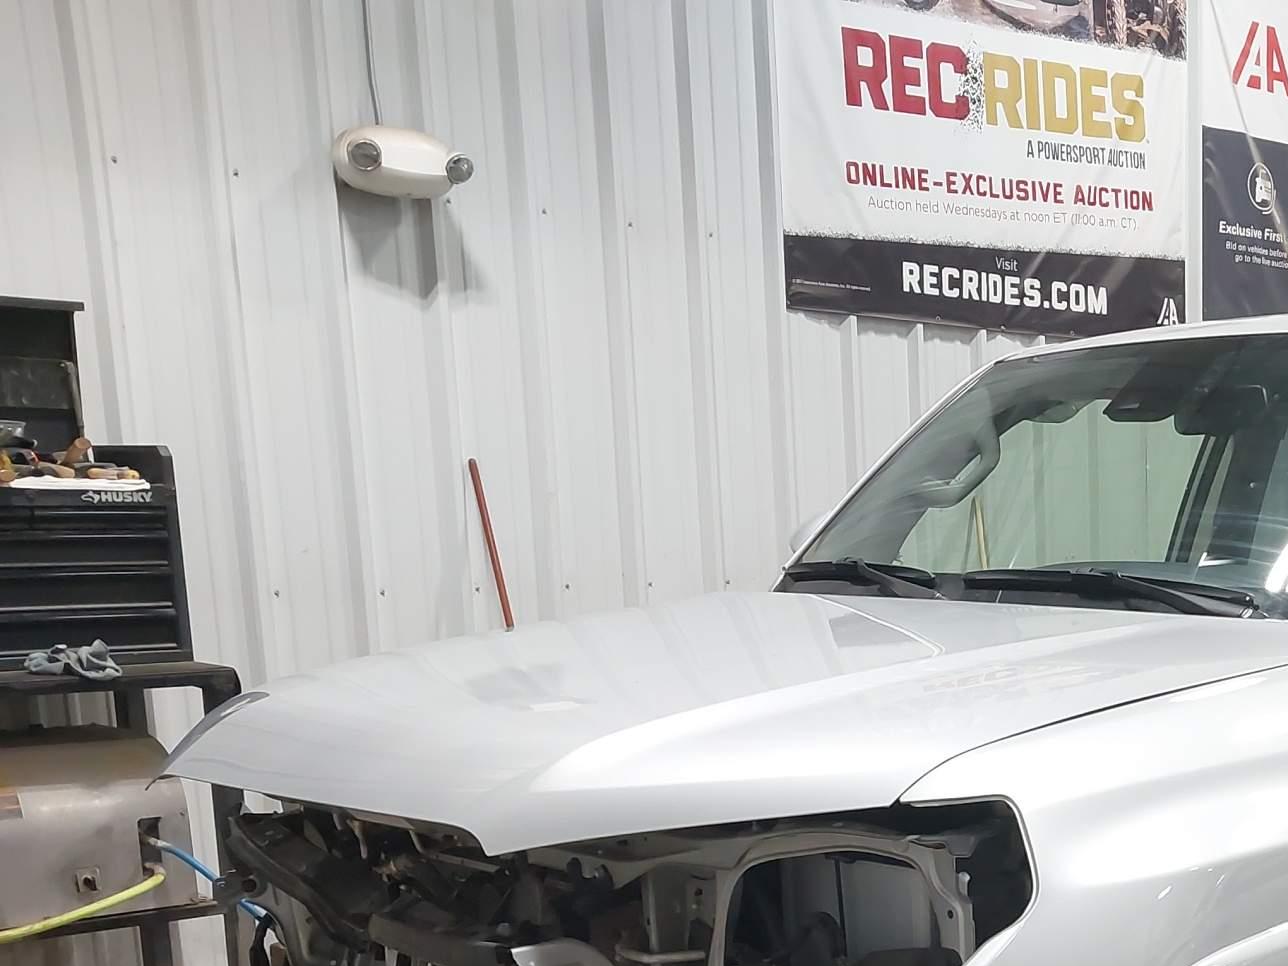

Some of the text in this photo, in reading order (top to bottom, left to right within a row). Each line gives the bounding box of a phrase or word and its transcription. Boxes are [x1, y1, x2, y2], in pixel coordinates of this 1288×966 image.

[841, 26, 1147, 143] REC RIDES
[1027, 140, 1146, 170] A POWERSPORT AUCTION
[846, 161, 1154, 211] ONLINE-EXCLUSIVE AUCTION
[868, 195, 912, 211] Auction
[916, 201, 939, 214] held
[943, 202, 1008, 221] Wednesdays
[1010, 211, 1020, 221] at
[1024, 211, 1050, 223] noon
[1053, 212, 1068, 223] ET
[1219, 221, 1262, 239] Exclusive
[1225, 241, 1237, 250] Bid
[1269, 248, 1287, 259] before
[1235, 254, 1243, 263] go
[1252, 255, 1261, 264] the
[995, 256, 1018, 273] Visit
[902, 261, 1108, 315] RECRIDES.COM
[101, 491, 153, 503] HUSKY
